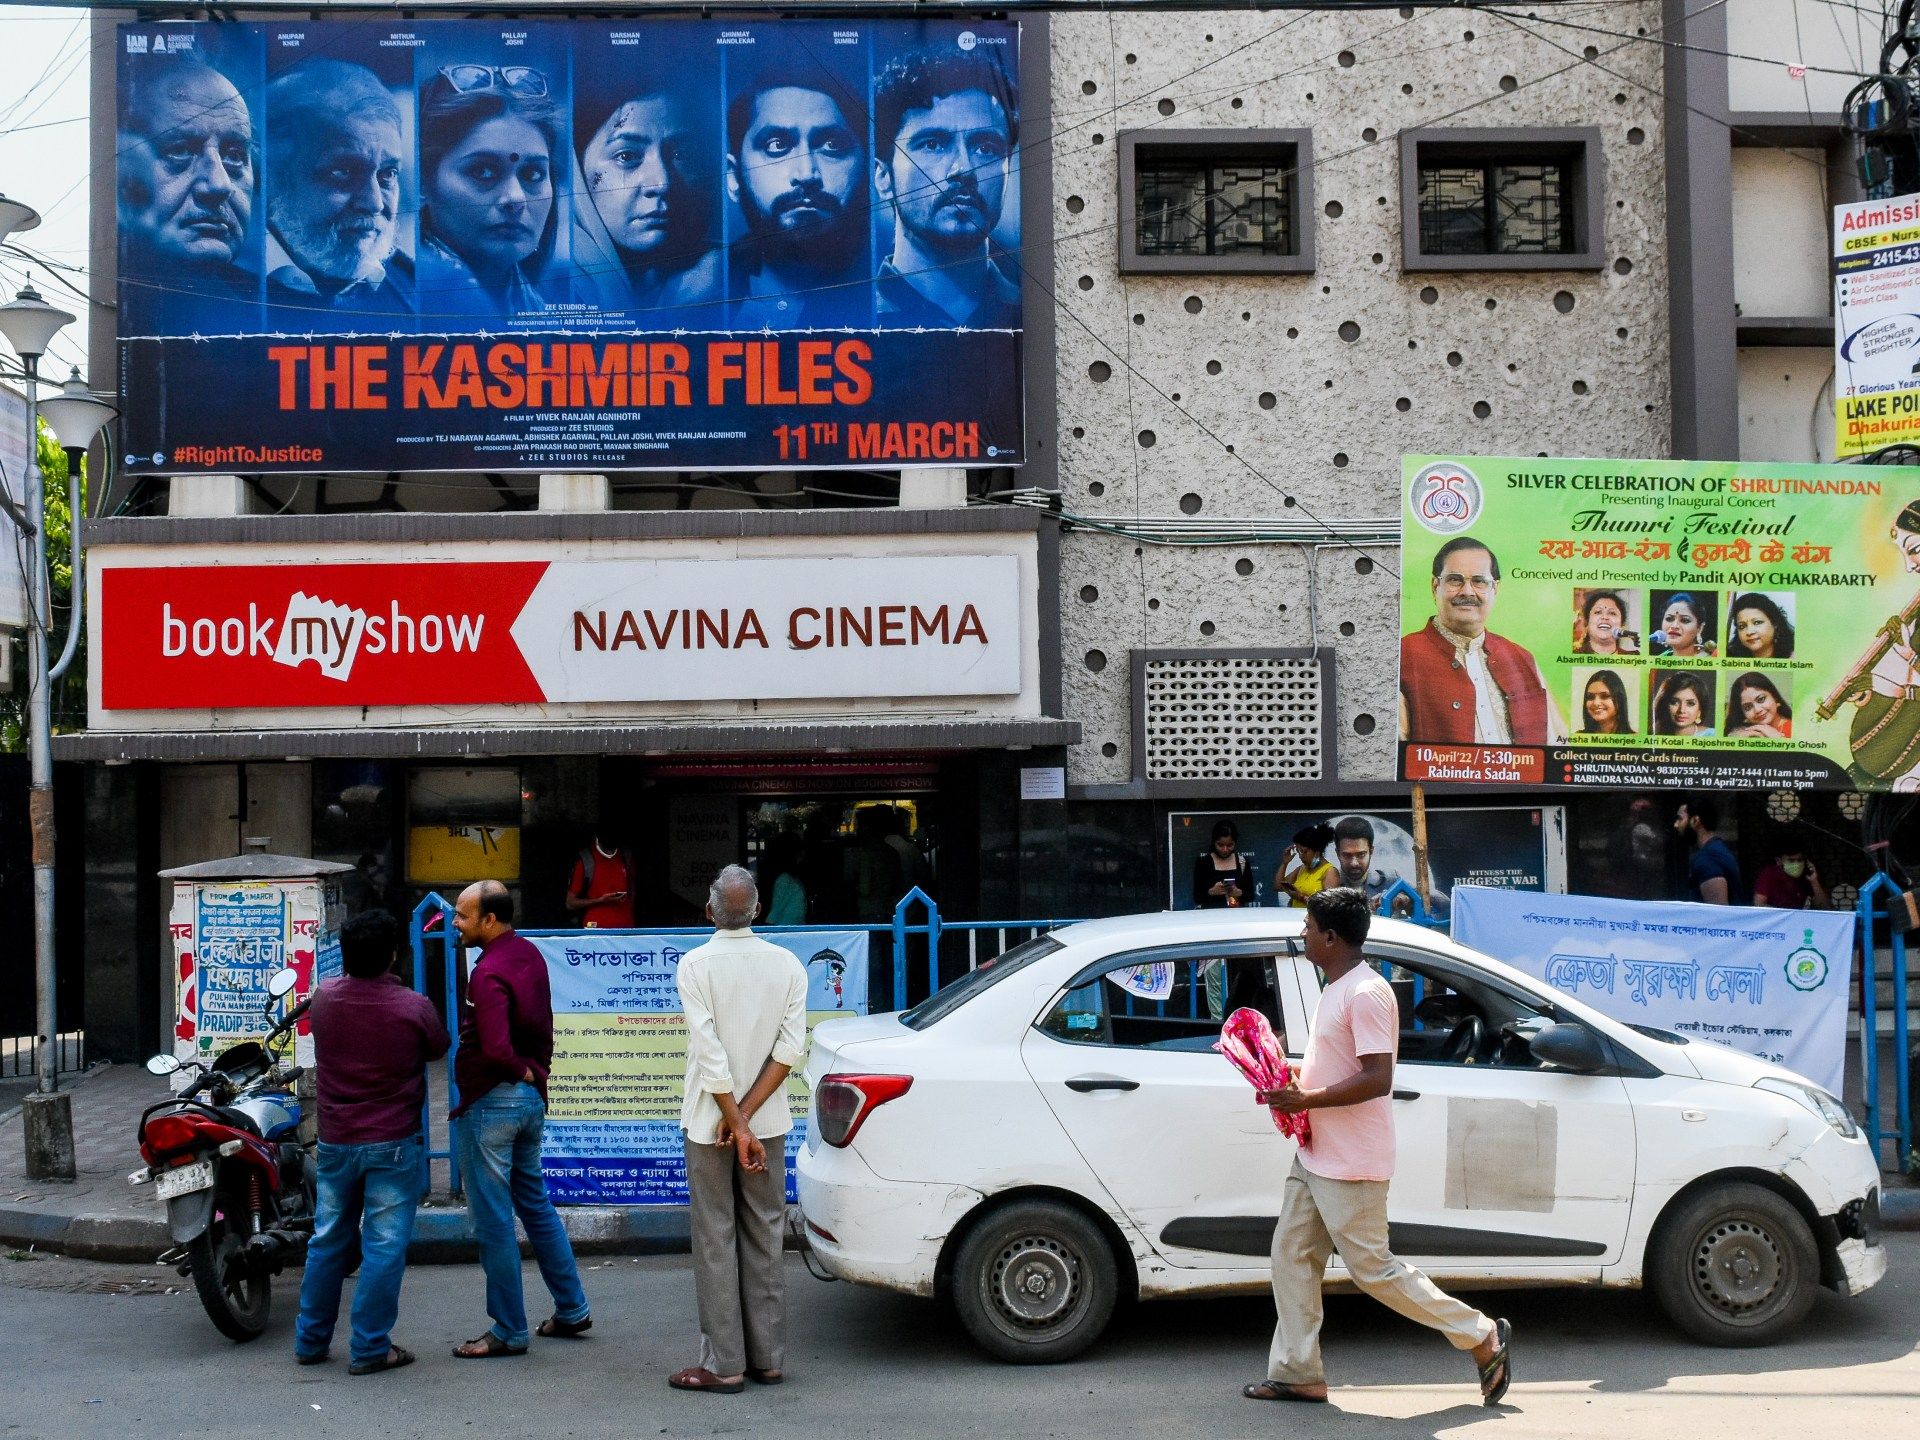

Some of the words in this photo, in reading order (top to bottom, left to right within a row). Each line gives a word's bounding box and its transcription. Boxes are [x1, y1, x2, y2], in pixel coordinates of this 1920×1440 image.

[379, 39, 426, 47] CHAKRABORTY
[611, 38, 639, 46] KUMAAR
[716, 37, 755, 45] MANDLEKAR
[834, 37, 858, 45] SUMBLI
[1846, 235, 1877, 250] CBSE
[544, 303, 557, 311] ZEE
[558, 303, 586, 311] STUDIOS
[1861, 322, 1897, 340] HIGHER
[1862, 326, 1914, 349] STRONGER
[1864, 337, 1913, 358] BRIGHTER
[267, 345, 388, 410] THE
[403, 343, 692, 409] KASHMIR
[707, 340, 873, 405] FILES
[1859, 382, 1895, 394] Glorious
[1846, 397, 1887, 420] LAKE
[525, 414, 534, 422] BY
[535, 413, 560, 421] VIVEK
[561, 413, 596, 421] RANJAN
[597, 412, 641, 421] AGNIHOTRI
[568, 424, 582, 432] ZEE
[583, 424, 614, 432] STUDIOS
[435, 434, 449, 443] TEJ
[450, 434, 484, 442] NARAYAN
[485, 434, 523, 443] AGARWAL,
[524, 433, 560, 442] ABHISHEK
[561, 433, 599, 442] AGARWAL,
[600, 433, 630, 441] PALLAVI
[631, 432, 654, 442] JOSHI,
[655, 432, 676, 440] VIVEK
[677, 431, 707, 440] RANJAN
[708, 431, 746, 439] AGNIHOTRI
[772, 422, 838, 460] 11TH
[848, 420, 979, 459] MARCH
[512, 443, 529, 451] JAYA
[578, 443, 603, 451] DHOTE,
[633, 442, 670, 450] SINGHANIA
[173, 446, 323, 466] #RightToJustice
[528, 453, 545, 461] ZEE
[549, 453, 588, 461] STUDIOS
[1507, 473, 1566, 489] SILVER
[1571, 474, 1695, 491] CELEBRATION
[1700, 477, 1727, 493] OF
[1730, 478, 1882, 496] SHRUTINANDAN
[1601, 493, 1664, 508] Presenting
[1668, 494, 1724, 509] Inaugural
[1727, 496, 1776, 508] Concert
[1571, 510, 1675, 533] Thumri
[1684, 512, 1797, 536] Festival
[1538, 538, 1672, 561] रस-भाव-रंग
[1692, 538, 1752, 569] ठुमरी
[1759, 539, 1785, 564] के
[1791, 541, 1833, 565] संग
[1511, 567, 1573, 580] Conceived
[1576, 568, 1598, 580] and
[1602, 569, 1659, 582] Presented
[1663, 571, 1677, 585] by
[1679, 571, 1724, 584] Pandit
[1728, 572, 1765, 586] AJOY
[1769, 572, 1877, 587] CHAKRABARTY
[163, 599, 484, 669] bookmyshow
[573, 608, 769, 652] NAVINA
[788, 604, 989, 651] CINEMA
[1556, 655, 1584, 664] Abanti
[1587, 656, 1647, 667] Bhattacharjee
[1655, 658, 1695, 668] Rageshri
[1696, 659, 1713, 667] Das
[1721, 659, 1751, 668] Sabina
[1753, 660, 1787, 669] Mumtaz
[1789, 660, 1814, 669] Islam
[1556, 735, 1589, 744] Ayesha
[1591, 736, 1636, 746] Mukherjee
[1661, 738, 1684, 746] Kotal
[1691, 738, 1736, 748] Rajoshree
[1738, 739, 1796, 750] Bhattacharya
[1798, 740, 1827, 749] Ghosh
[1483, 750, 1535, 769] 5:30pm
[1553, 751, 1588, 761] Collect
[1590, 753, 1612, 764] your
[1614, 752, 1640, 764] Entry
[1641, 753, 1670, 763] Cards
[1672, 753, 1699, 763] from:
[1428, 765, 1482, 779] Rabindra
[1485, 767, 1521, 781] Sadan
[1573, 763, 1649, 774] SHRUTINANDAN
[1656, 765, 1710, 775] 9830755544
[1716, 767, 1762, 777] 2417-1444
[1764, 768, 1792, 778] (11am
[1793, 769, 1803, 778] to
[1804, 769, 1829, 780] 5pm)
[1573, 774, 1622, 784] RABINDRA
[1623, 775, 1656, 785] SADAN
[1663, 776, 1682, 788] only
[1756, 779, 1781, 788] 11am
[1782, 779, 1792, 788] to
[1793, 780, 1814, 791] 5pm
[677, 813, 729, 827] NAVINA
[676, 829, 731, 842] CINEMA
[1453, 877, 1509, 886] BIGGEST
[1512, 876, 1539, 885] WAR
[1522, 912, 1570, 927] পশ্চিমবঙ্গের
[1573, 916, 1606, 930] মাননীয়া
[1609, 917, 1640, 933] মুখ্যমন্ত্রী
[1643, 922, 1668, 934] মমতা
[1671, 923, 1736, 939] বন্দ্যোপাধ্যায়ের
[565, 947, 657, 967] উপভোক্তা
[621, 970, 674, 983] পশ্চিমবঙ্গ
[1544, 952, 1618, 995] ক্রেতা
[1623, 958, 1700, 1006] সুরক্ষা
[1705, 962, 1766, 1005] মেলা
[607, 986, 632, 995] ক্রেতা
[635, 986, 661, 996] সুরক্ষা
[597, 997, 619, 1008] মির্জা
[623, 998, 648, 1008] গালিব
[203, 1014, 243, 1033] PRADIP
[618, 1015, 666, 1025] উপভোক্তাদের
[668, 1015, 685, 1025] প্রতি
[588, 1166, 625, 1178] বিষয়ক
[629, 1168, 638, 1178] ও
[642, 1167, 669, 1178] ন্যায্য
[600, 1180, 637, 1189] কলকাতা
